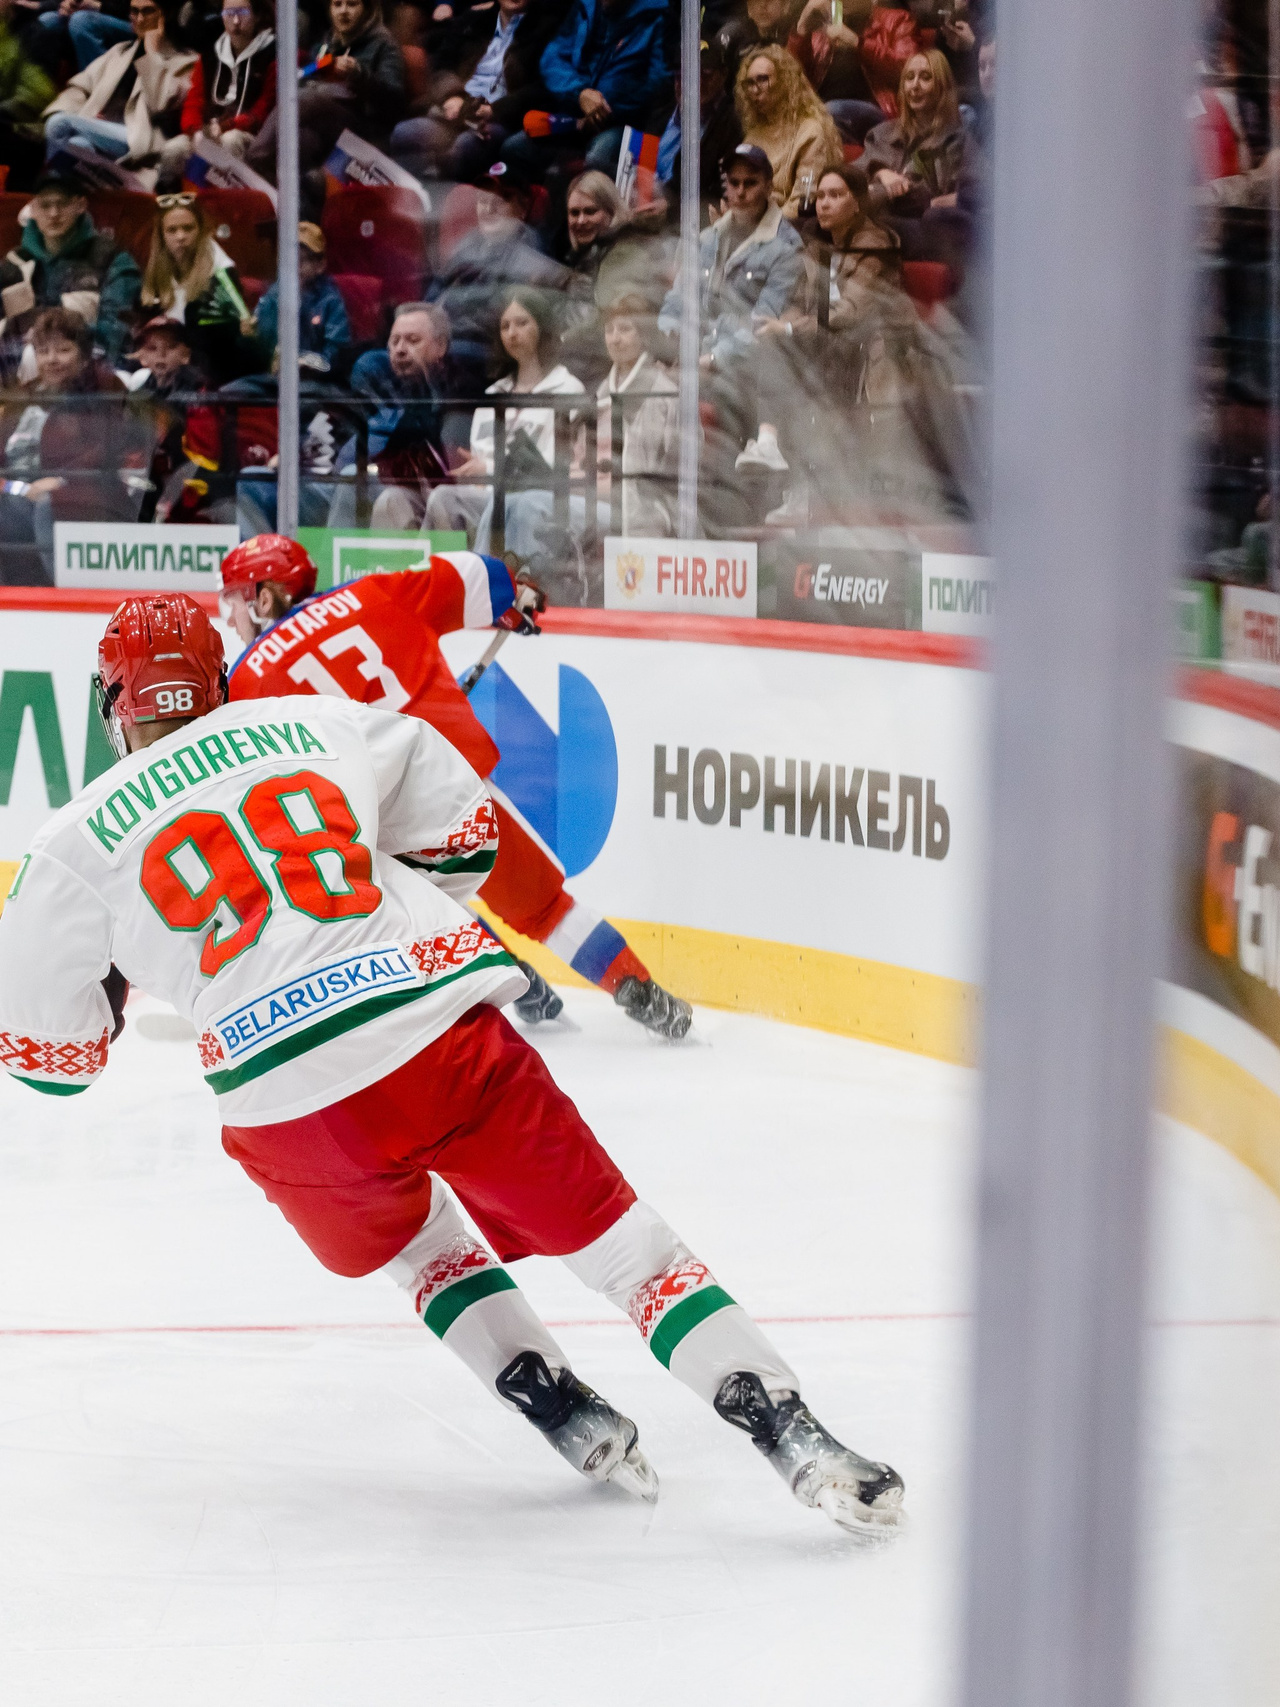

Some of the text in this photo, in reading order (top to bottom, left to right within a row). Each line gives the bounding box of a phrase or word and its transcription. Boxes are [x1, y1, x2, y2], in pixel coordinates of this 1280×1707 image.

[66, 542, 229, 572] ПОЛИПЛАСТ
[657, 556, 748, 599] FHR.RU
[929, 576, 995, 614] ПОЛИП
[246, 589, 363, 678] POLTAPOV
[287, 624, 412, 711] 13
[155, 688, 194, 713] 98
[86, 722, 327, 854] KOVGORENYA
[653, 743, 951, 861] НОРНИКЕЛЬ
[139, 769, 383, 978] 98
[220, 954, 412, 1051] BELARUSKALI
